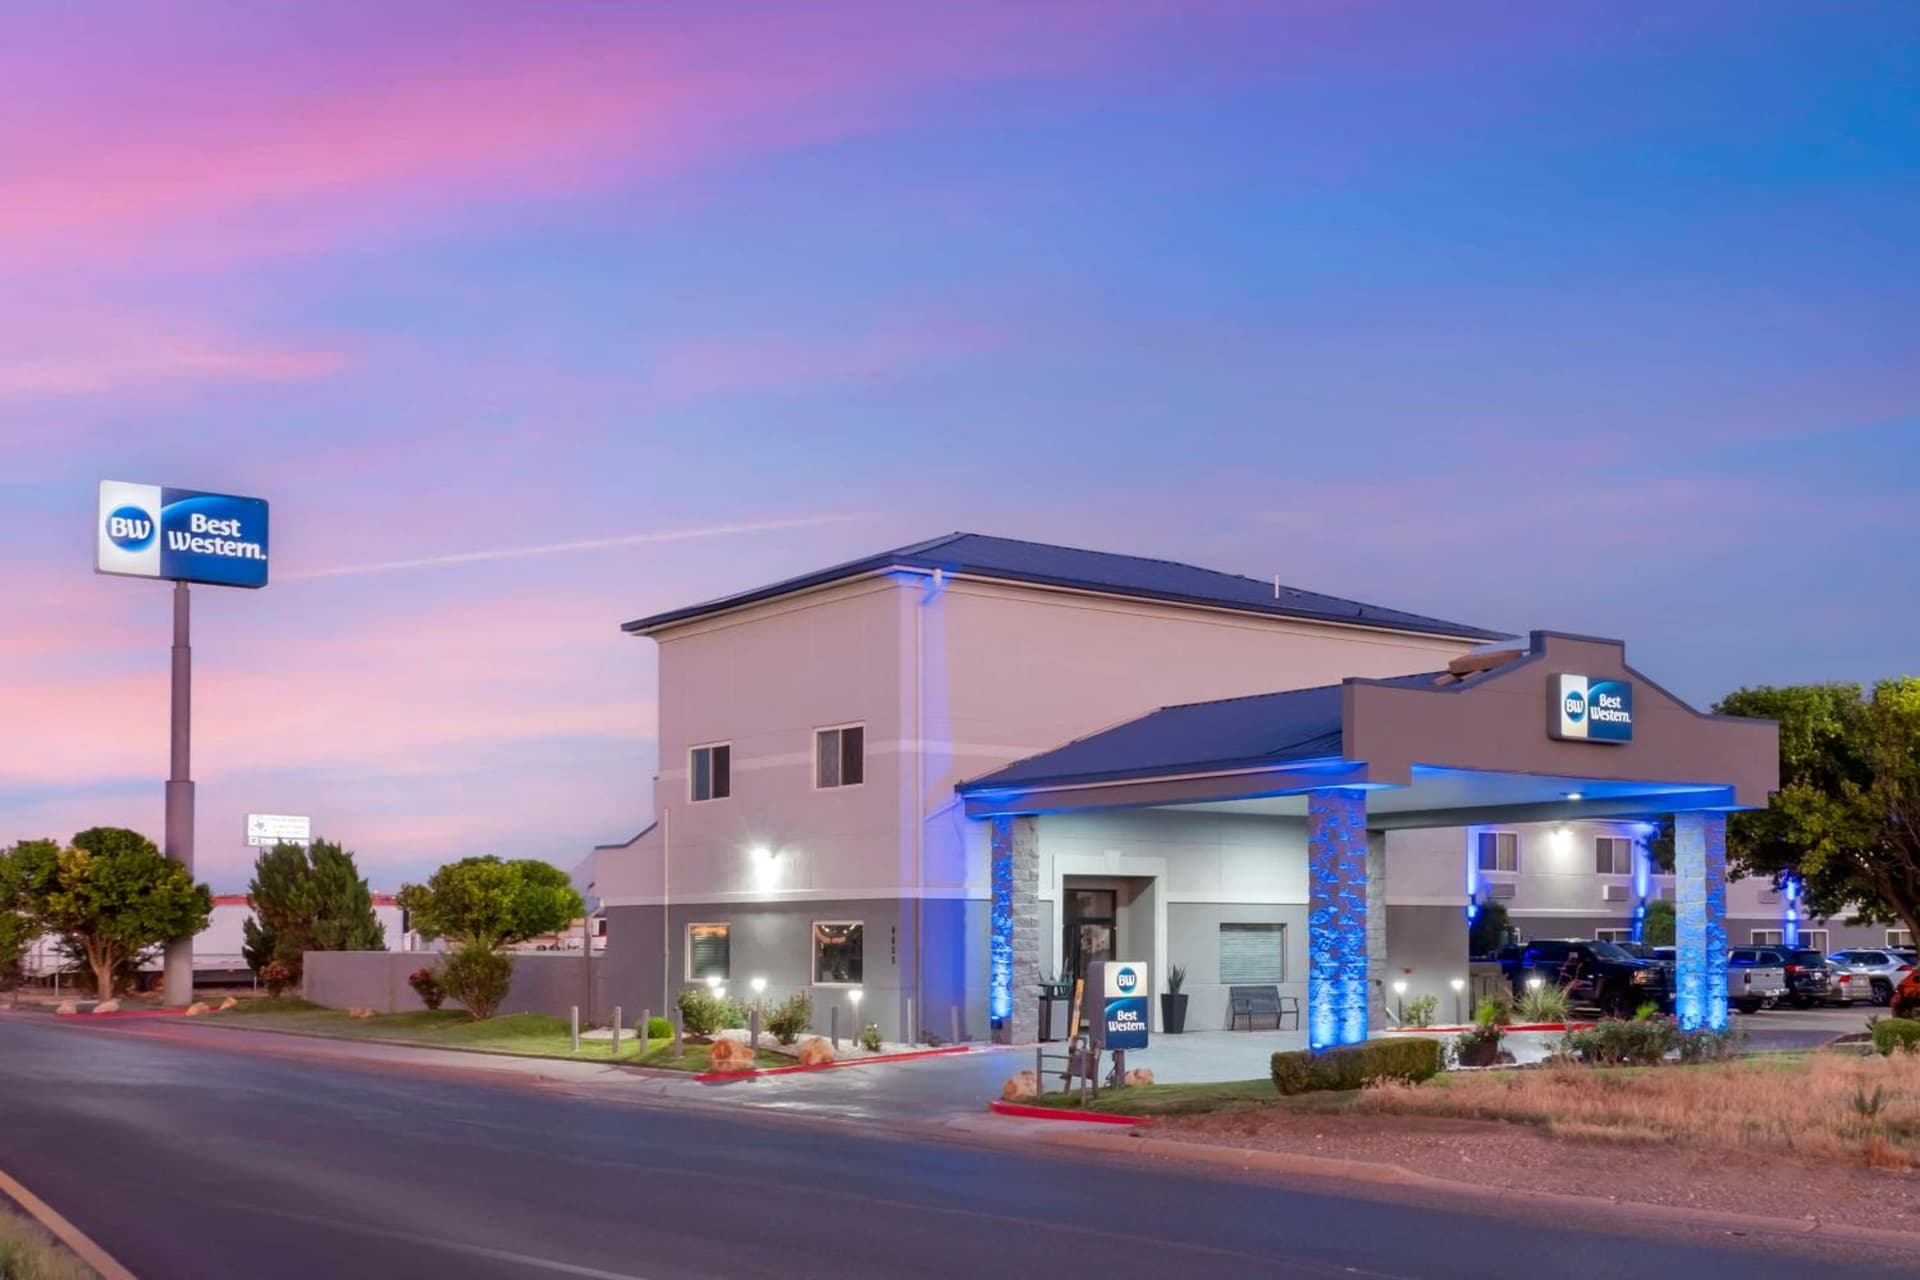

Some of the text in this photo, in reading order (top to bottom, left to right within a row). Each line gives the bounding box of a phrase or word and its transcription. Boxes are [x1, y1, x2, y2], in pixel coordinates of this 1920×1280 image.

[110, 517, 151, 540] BW
[190, 513, 241, 537] Best
[1566, 698, 1584, 713] BW
[1599, 693, 1622, 708] Best
[1118, 974, 1135, 986] BW
[1117, 1010, 1138, 1021] Best
